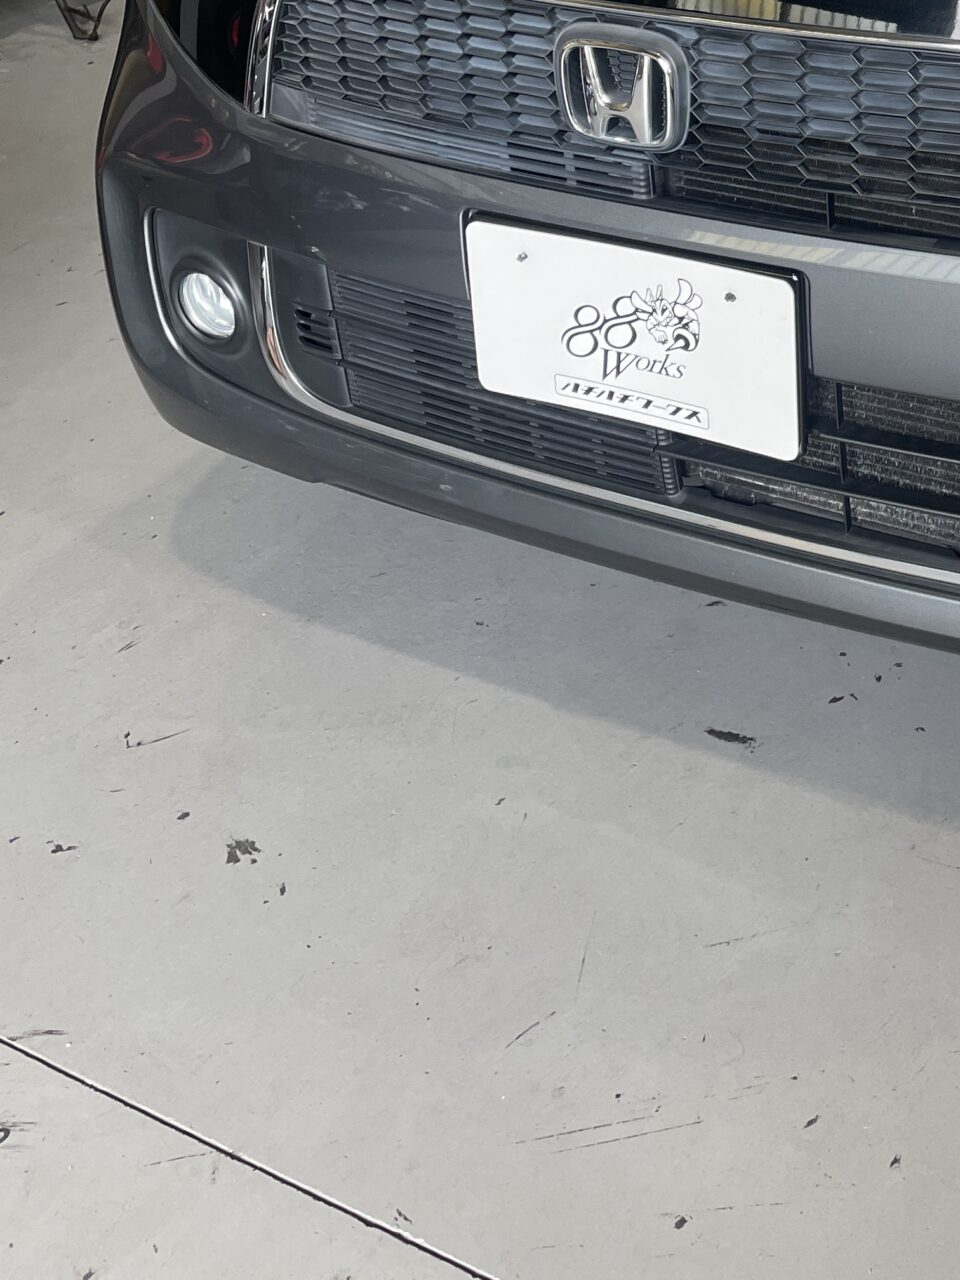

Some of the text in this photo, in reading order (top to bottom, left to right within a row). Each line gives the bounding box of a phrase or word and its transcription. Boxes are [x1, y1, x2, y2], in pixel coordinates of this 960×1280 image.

[600, 347, 687, 382] Works
[561, 382, 702, 424] ハチハチワークス
